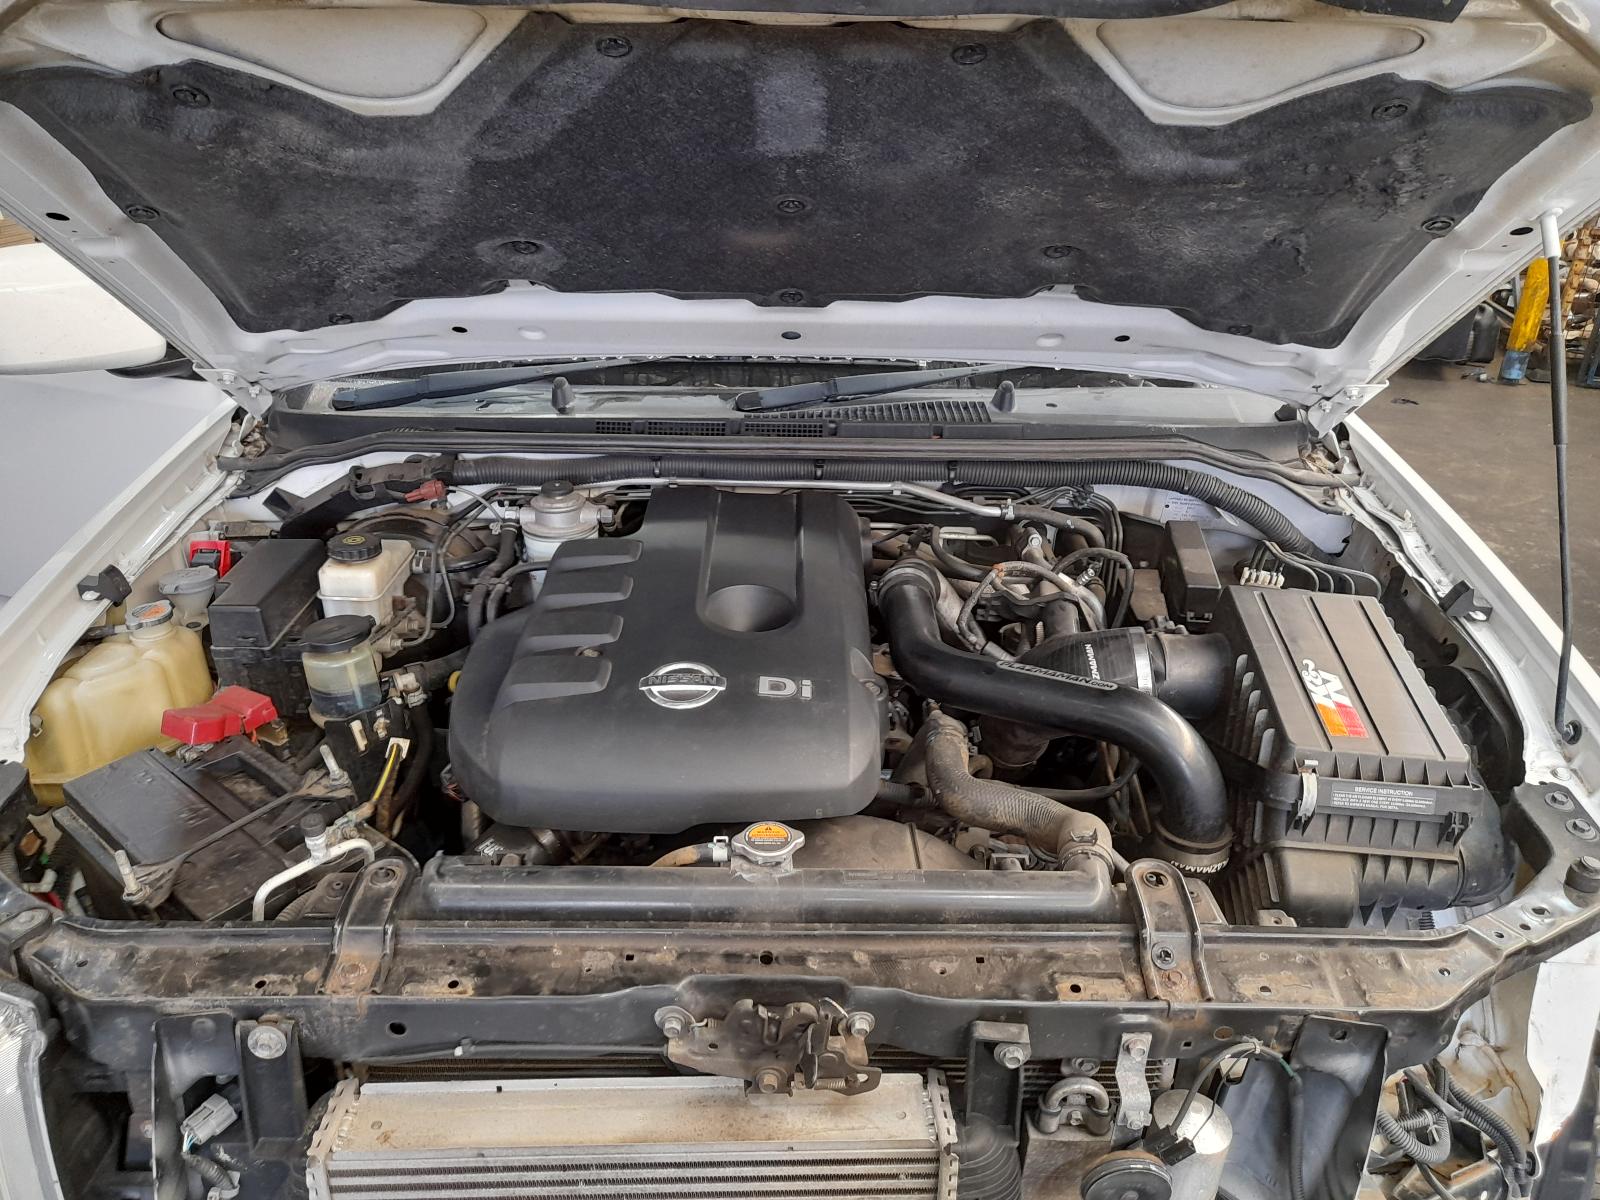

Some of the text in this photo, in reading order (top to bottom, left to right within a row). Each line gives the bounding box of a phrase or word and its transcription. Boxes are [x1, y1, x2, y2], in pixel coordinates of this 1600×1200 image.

[648, 674, 717, 685] NISSAN
[758, 676, 812, 699] Di
[1354, 786, 1414, 797] SERVICE INSTRUCTION
